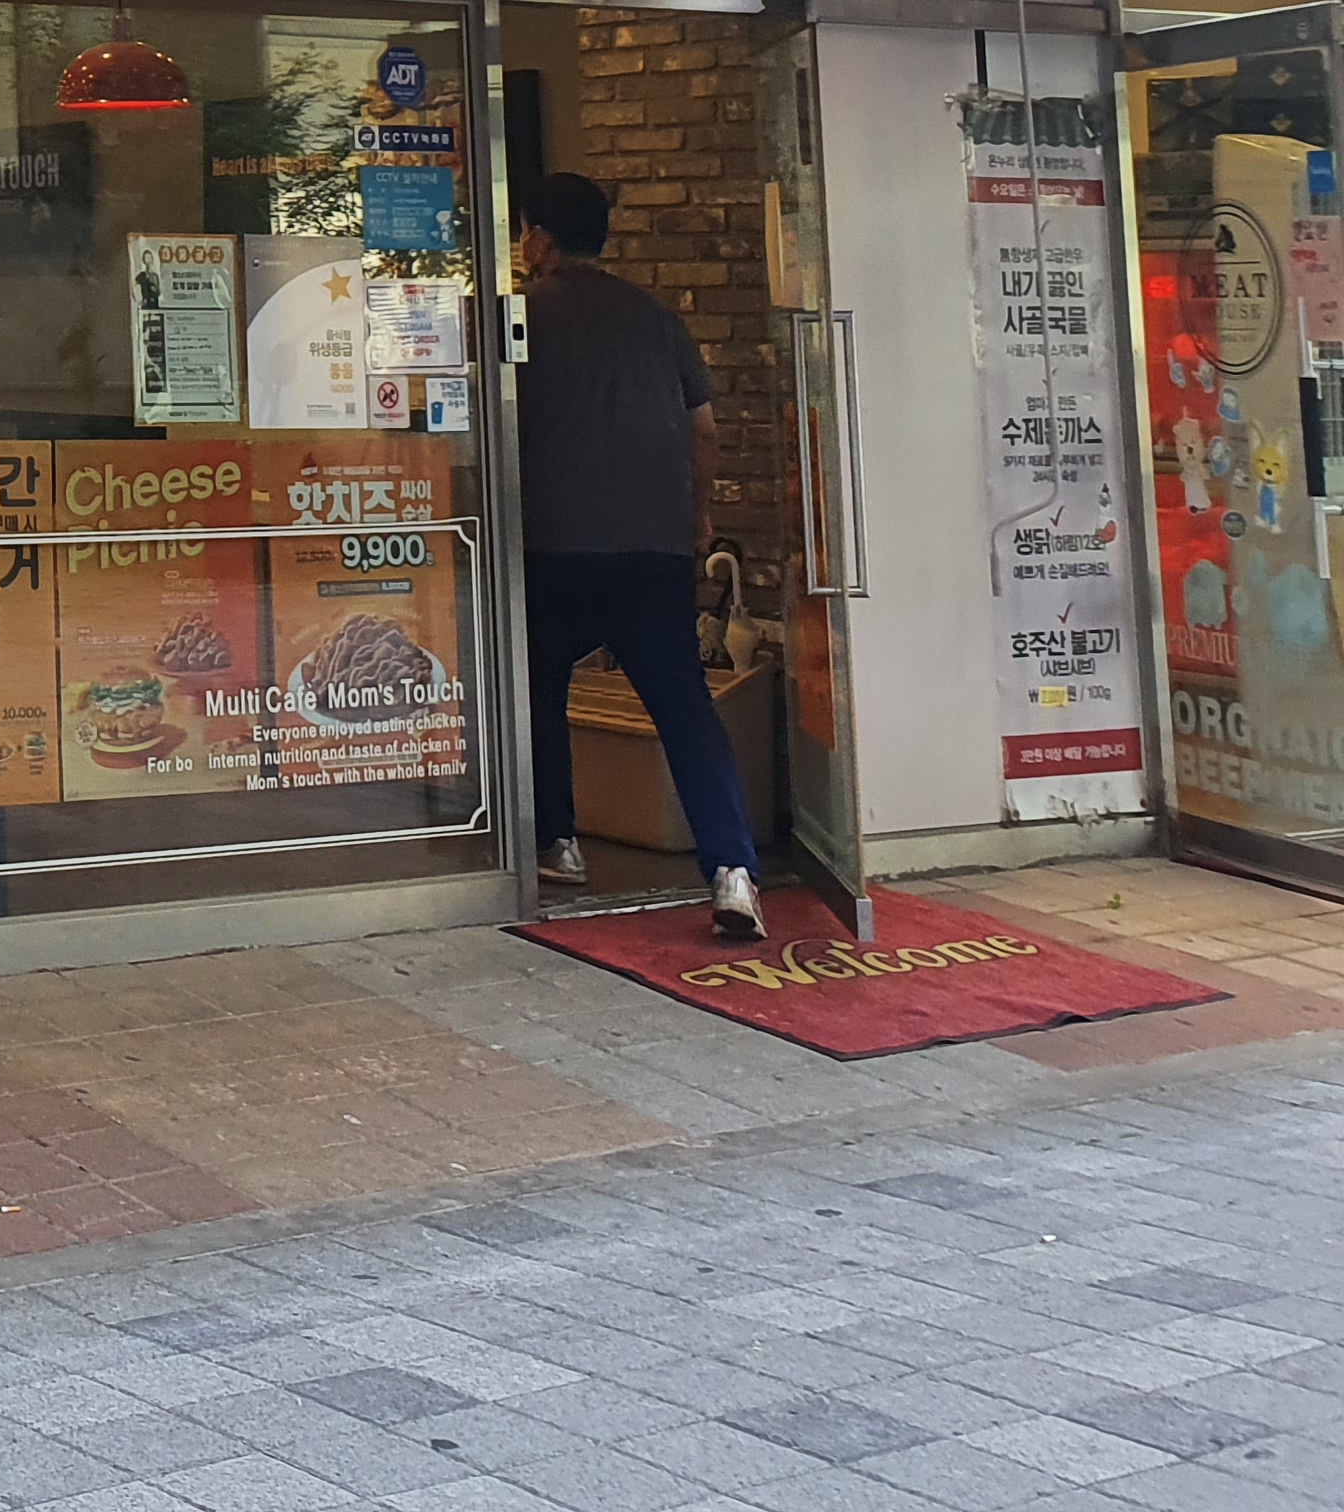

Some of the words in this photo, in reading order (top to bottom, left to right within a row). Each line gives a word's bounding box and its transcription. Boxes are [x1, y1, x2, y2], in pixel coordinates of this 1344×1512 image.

[386, 64, 419, 86] ADT
[376, 172, 399, 182] CCTV
[1047, 271, 1085, 298] 끓인
[1190, 272, 1268, 298] MEAT
[1025, 396, 1049, 412] 엄마
[65, 460, 241, 517] Cheese
[287, 480, 398, 525] 핫치즈
[1011, 630, 1066, 658] 호주산
[1070, 628, 1121, 655] 불고기
[205, 688, 260, 717] Multi
[327, 681, 394, 710] Mom's
[400, 676, 464, 704] Touch
[252, 724, 315, 744] Everyone
[319, 720, 371, 741] enjoyed
[373, 717, 413, 736] eating
[415, 714, 466, 733] chicken
[147, 757, 172, 774] For
[208, 750, 260, 769] internal
[264, 746, 320, 766] nutrition
[321, 744, 345, 760] and
[349, 743, 381, 758] taste
[384, 741, 398, 756] of
[401, 738, 450, 756] chicken
[454, 736, 467, 751] in
[246, 773, 290, 792] Mom's
[293, 770, 330, 788] touch
[334, 767, 360, 785] with
[363, 765, 384, 782] the
[387, 762, 425, 780] whole
[680, 933, 1039, 990] Welcome
